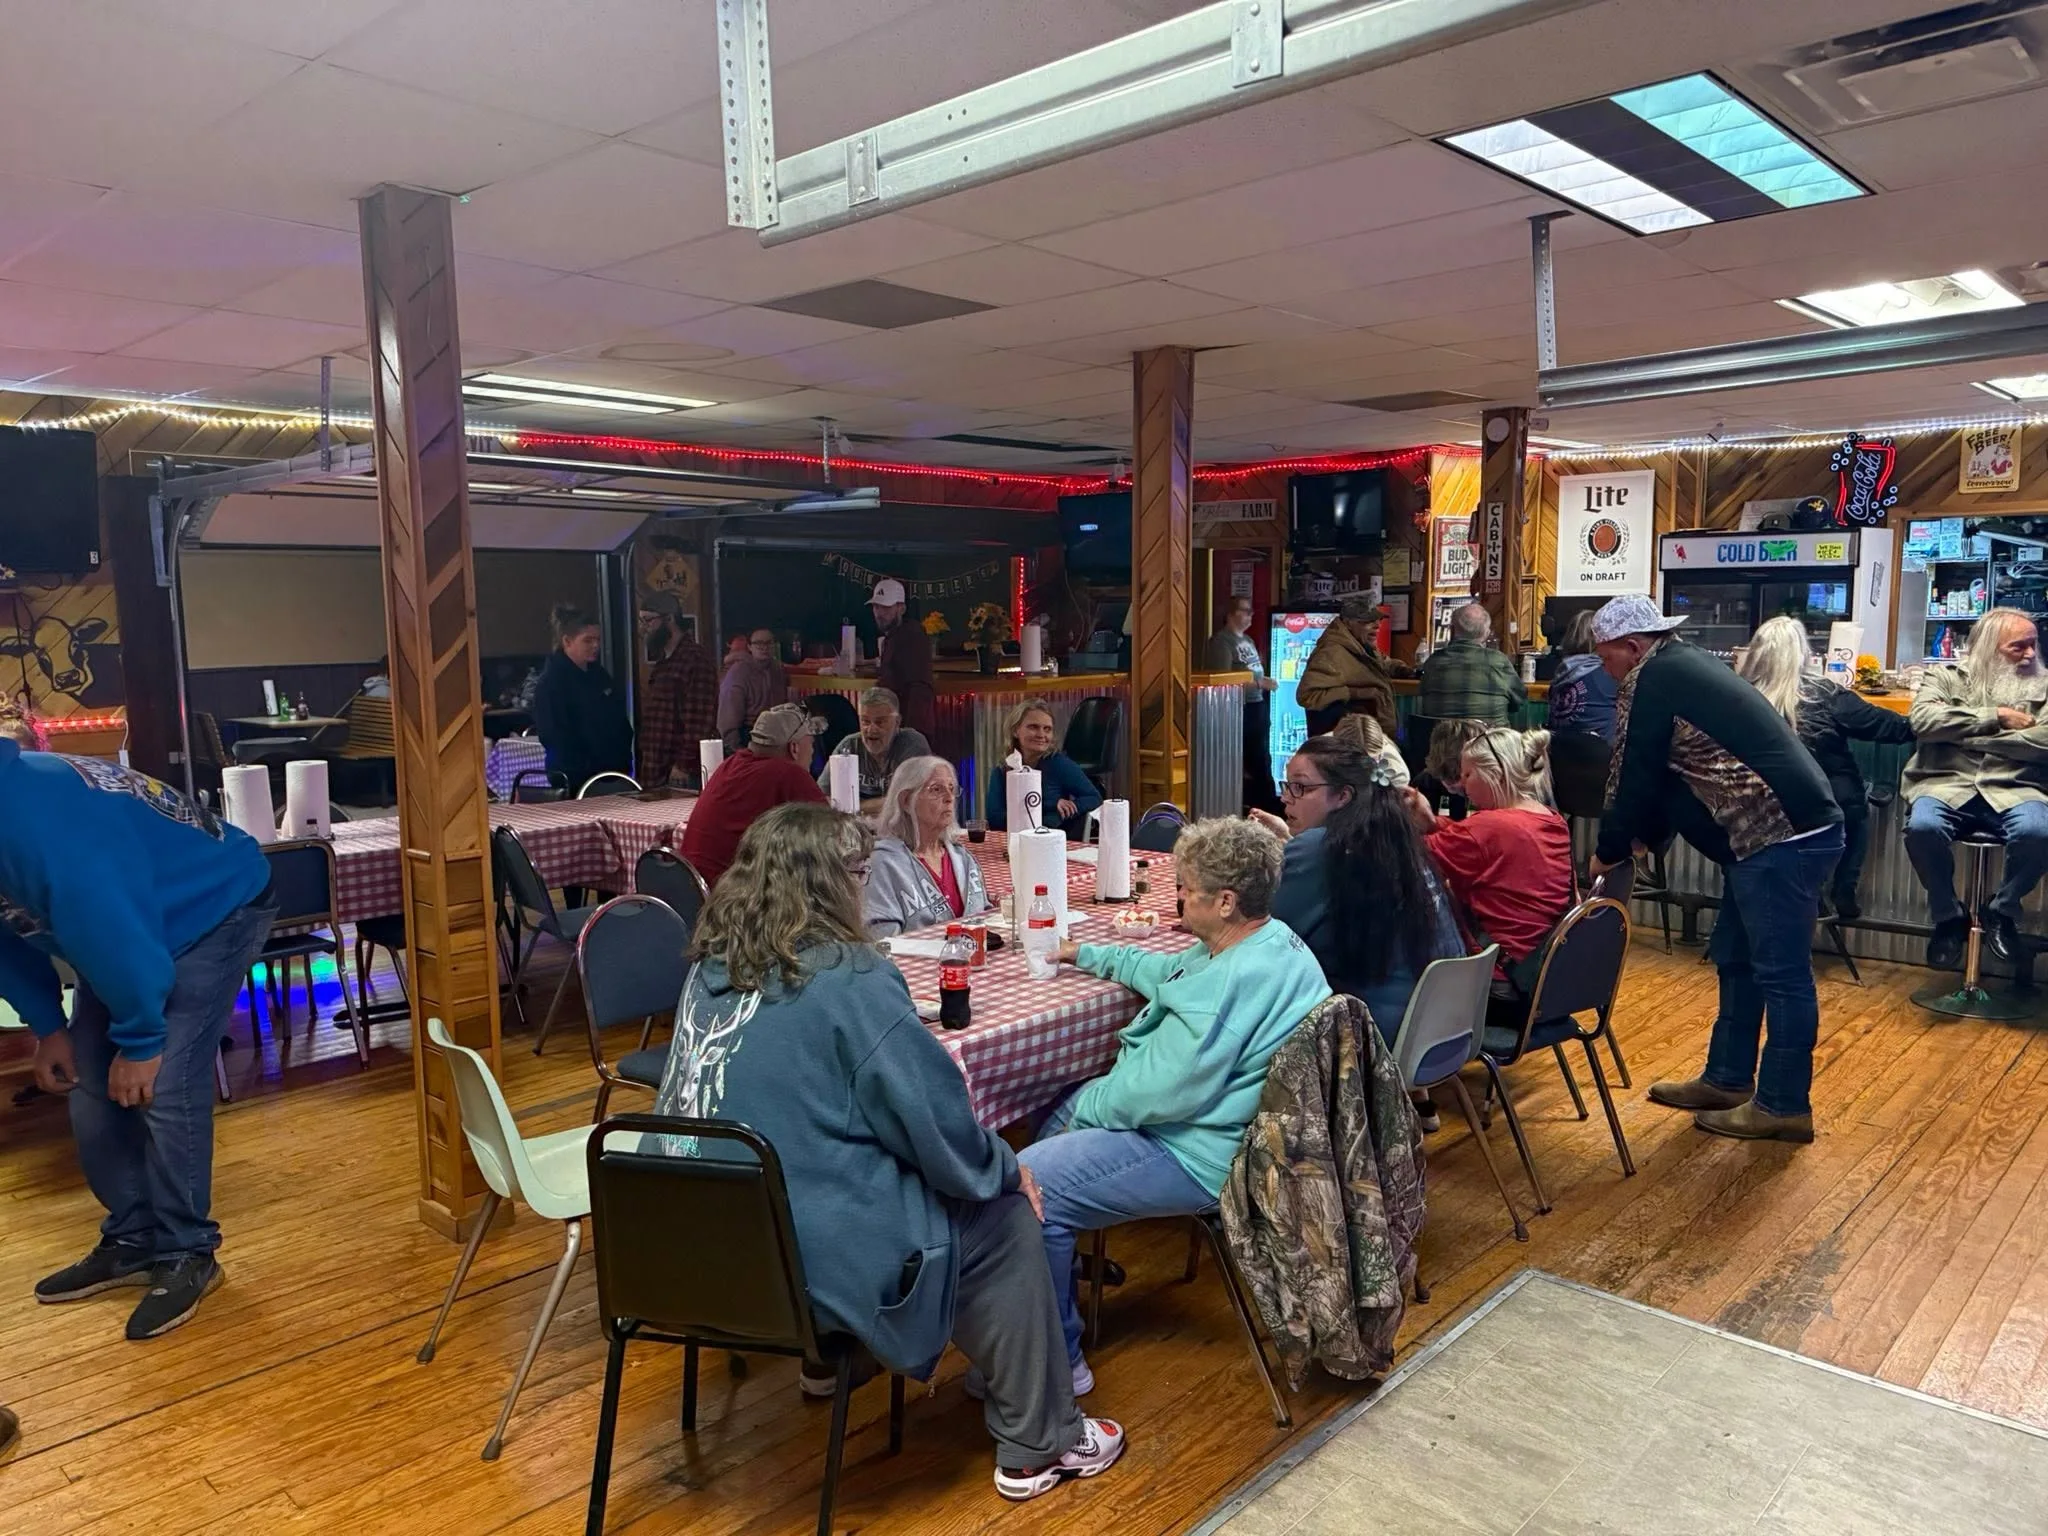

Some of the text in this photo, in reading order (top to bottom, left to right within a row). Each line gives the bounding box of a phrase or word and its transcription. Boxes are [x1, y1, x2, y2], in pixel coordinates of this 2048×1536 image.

[1966, 427, 2000, 449] FREE
[1584, 486, 1628, 513] Lite
[1241, 503, 1272, 518] FARM
[1488, 505, 1500, 577] CABINS
[1447, 549, 1468, 561] BUD
[1717, 543, 1755, 562] COLD
[1443, 562, 1471, 575] LIGHT
[1580, 572, 1626, 581] ON DRAFT
